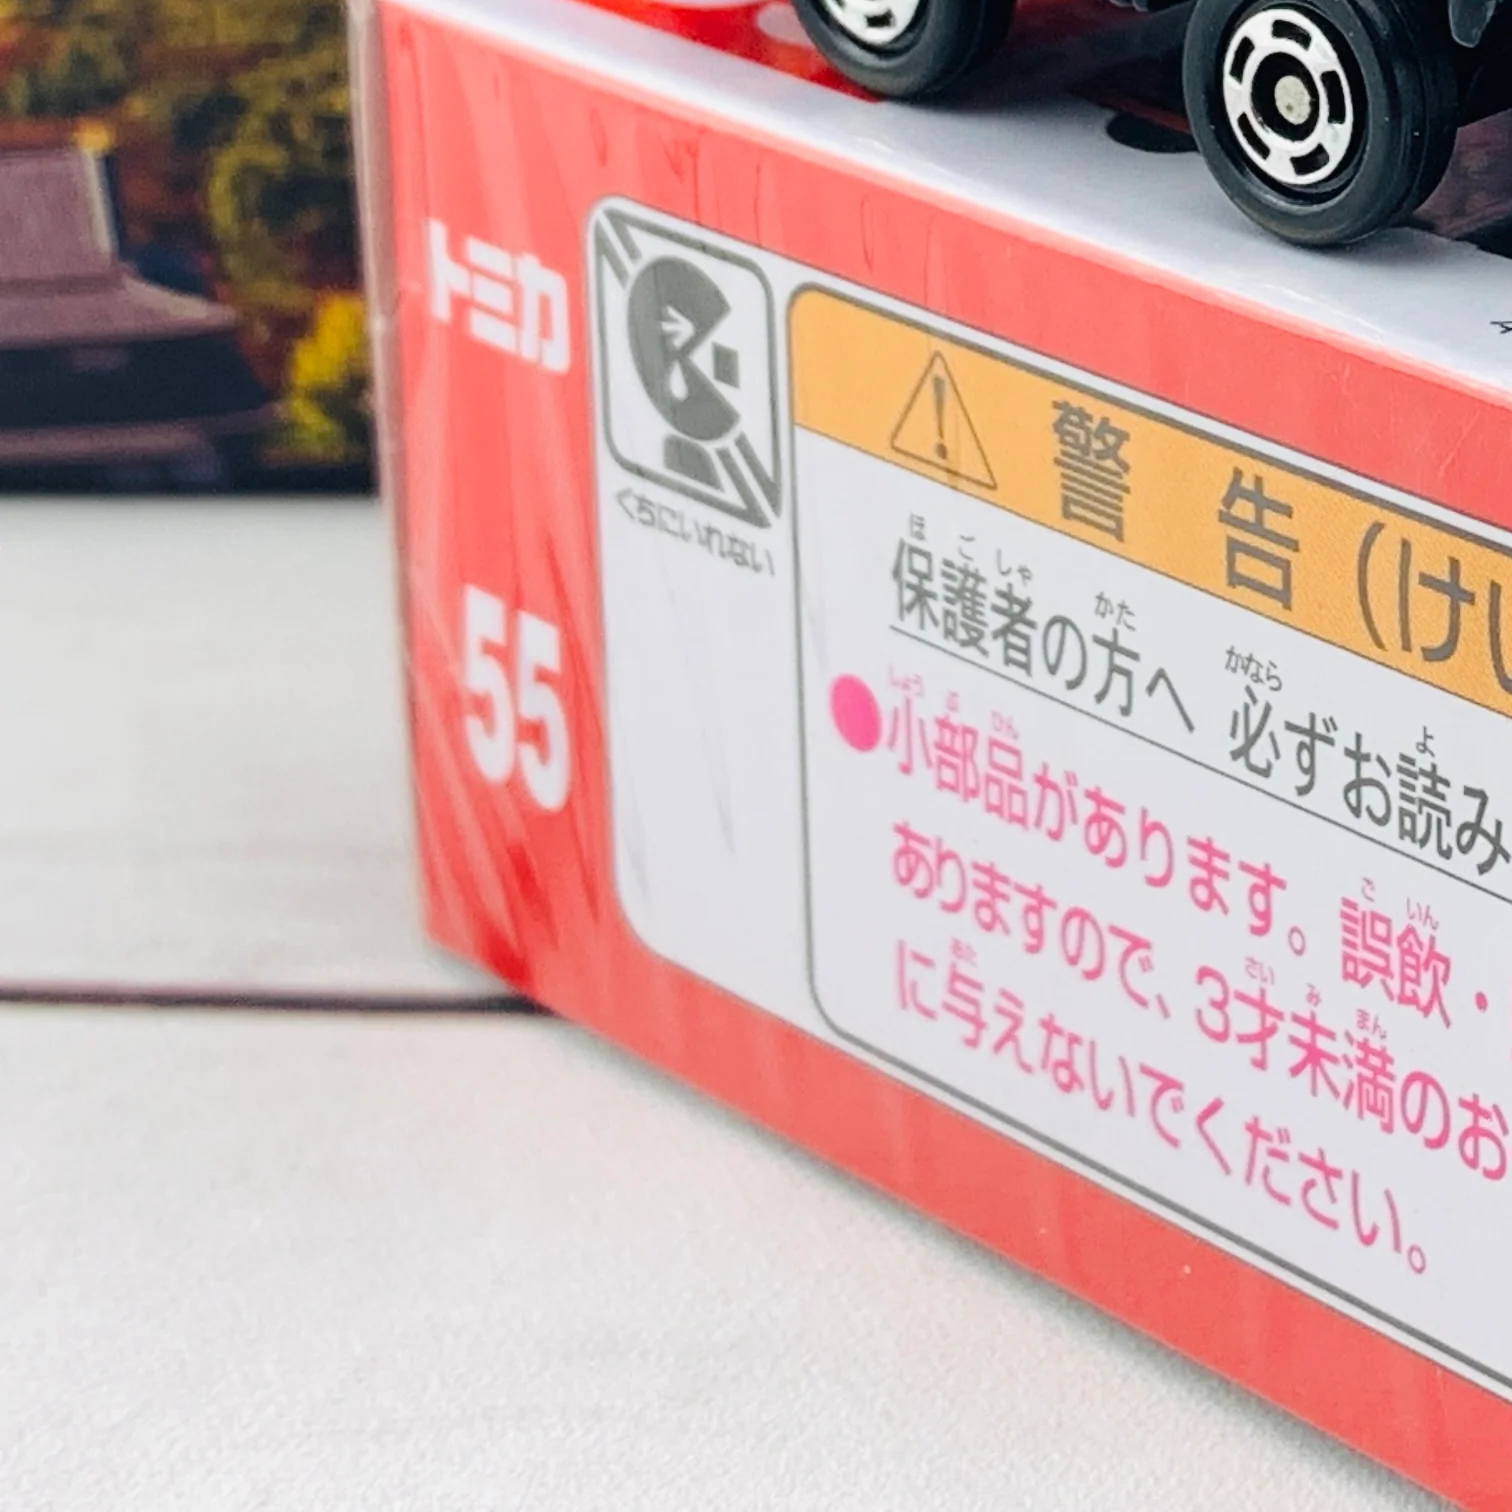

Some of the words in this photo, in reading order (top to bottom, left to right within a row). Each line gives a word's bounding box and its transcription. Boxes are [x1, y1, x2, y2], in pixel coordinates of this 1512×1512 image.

[426, 217, 571, 375] トミカ
[615, 489, 776, 578] くちにいれない
[462, 582, 572, 813] 55
[890, 536, 1195, 734] 保護者の方へ
[1225, 644, 1284, 693] かなら
[1414, 726, 1436, 758] よ
[1406, 895, 1439, 932] いん
[897, 938, 1427, 1275] に与えないでください。
